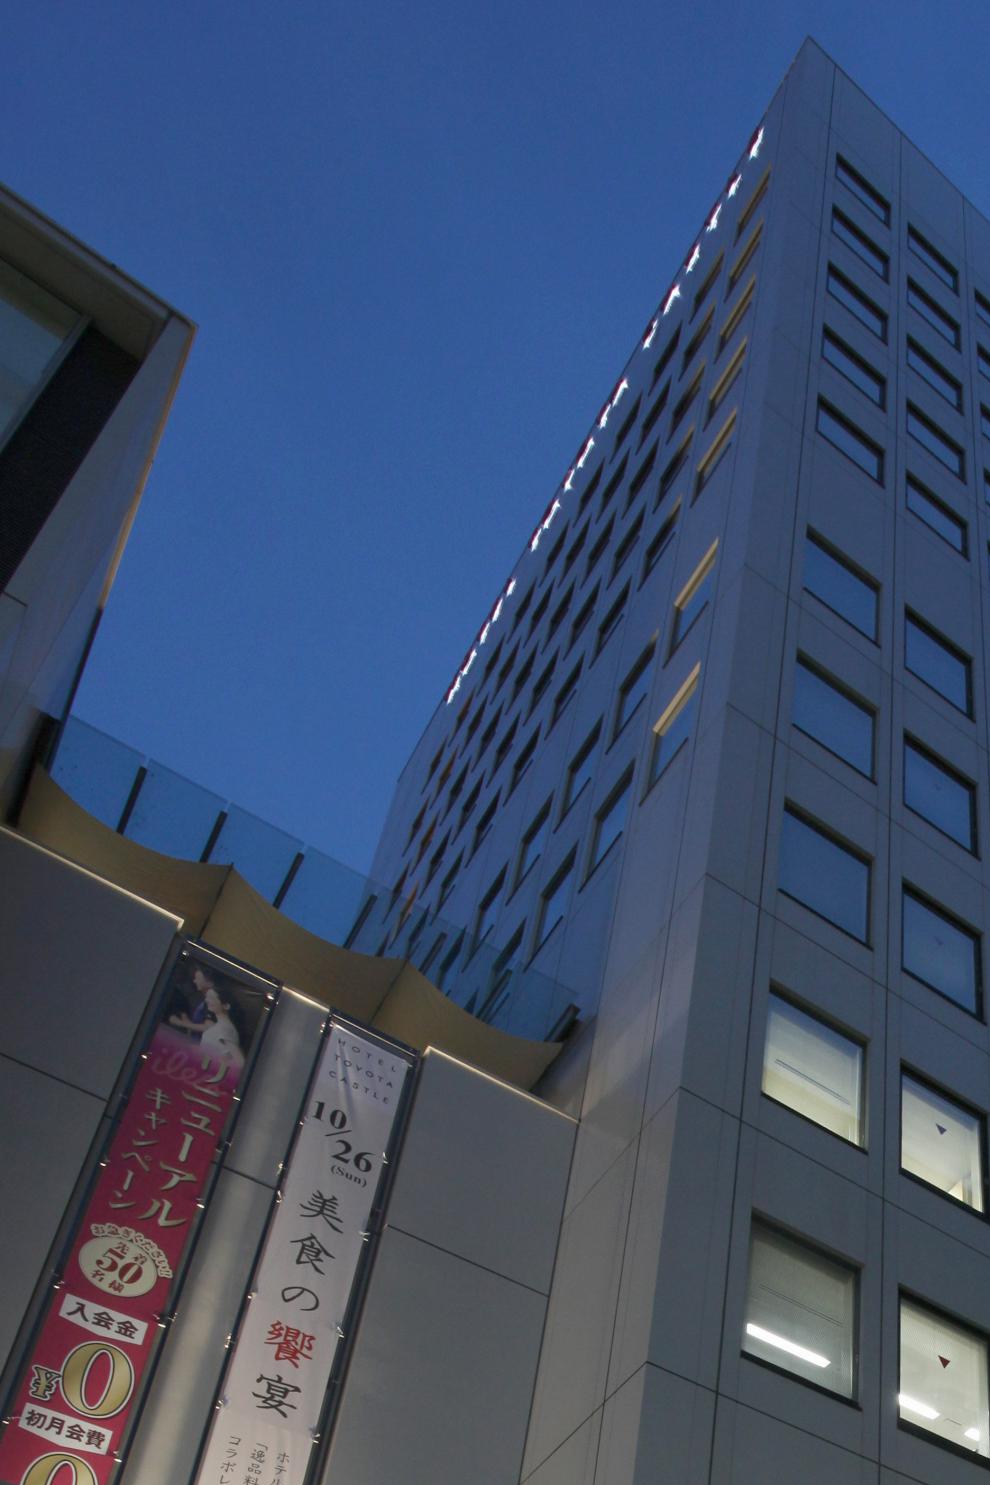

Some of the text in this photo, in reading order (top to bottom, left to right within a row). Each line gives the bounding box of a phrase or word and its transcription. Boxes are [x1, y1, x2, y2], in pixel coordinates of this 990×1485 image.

[333, 1053, 394, 1089] TOYOTA
[337, 1037, 398, 1073] HOTEL
[328, 1069, 390, 1105] CASTLE
[109, 1087, 172, 1210] キャンペーン
[138, 1055, 231, 1228] リニューアル
[330, 1163, 368, 1188] (Sun)
[96, 1248, 143, 1285] 50
[67, 1301, 139, 1340] 入会金
[252, 1190, 344, 1418] 美食の饗宴
[25, 1409, 106, 1450] 初月会費
